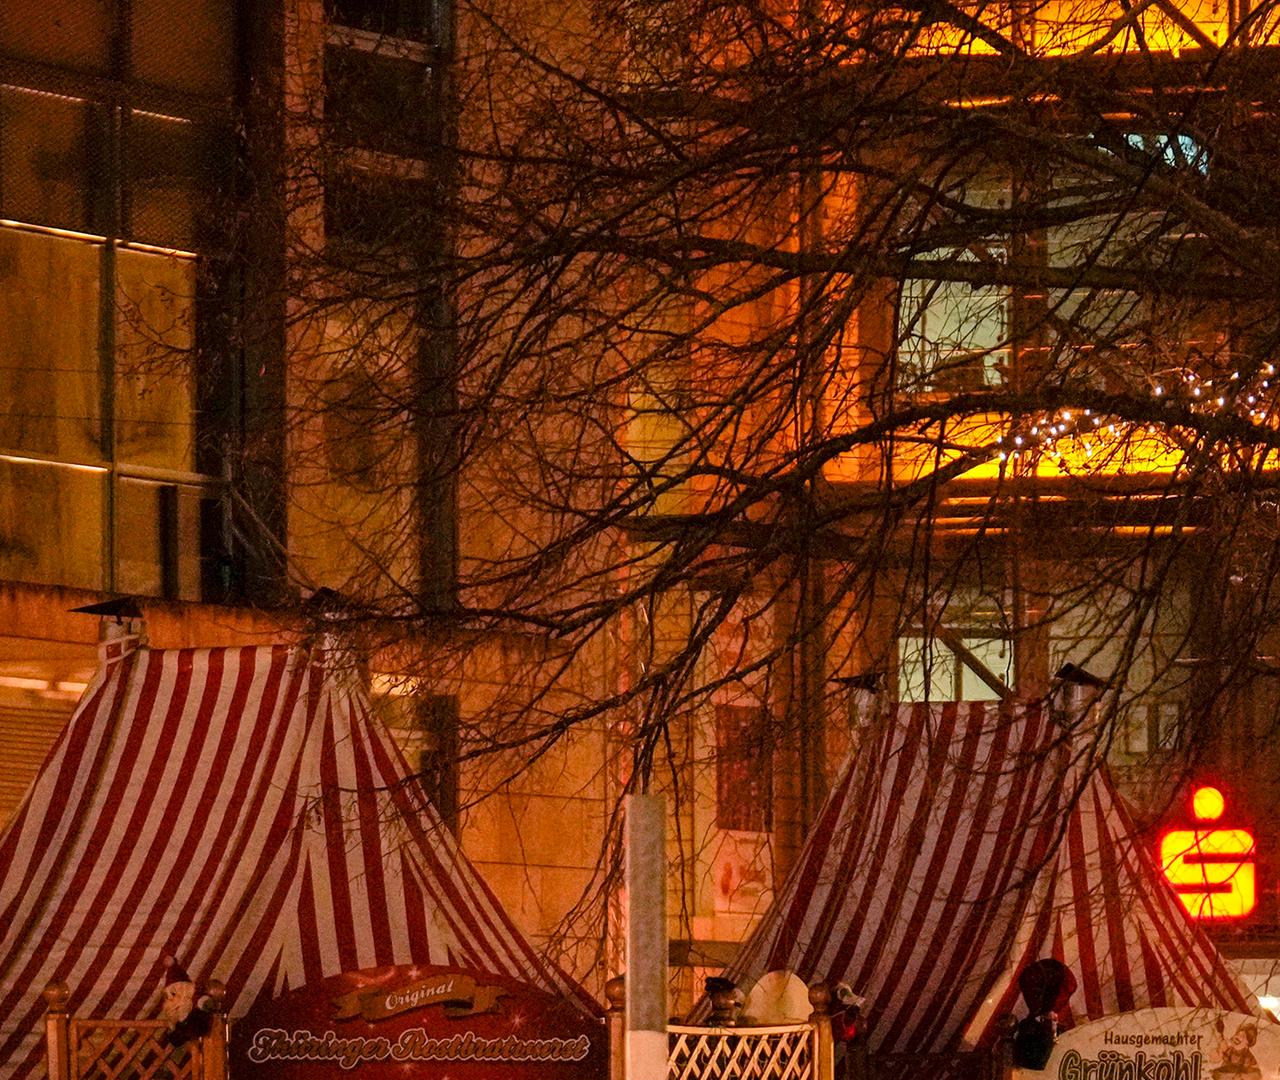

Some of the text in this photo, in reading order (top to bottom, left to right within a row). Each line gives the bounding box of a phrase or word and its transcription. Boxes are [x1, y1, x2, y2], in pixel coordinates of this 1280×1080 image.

[385, 980, 454, 1010] Original
[249, 1027, 591, 1069] Thüringer Rostbratwurst
[1104, 1030, 1204, 1050] Hausgemachter
